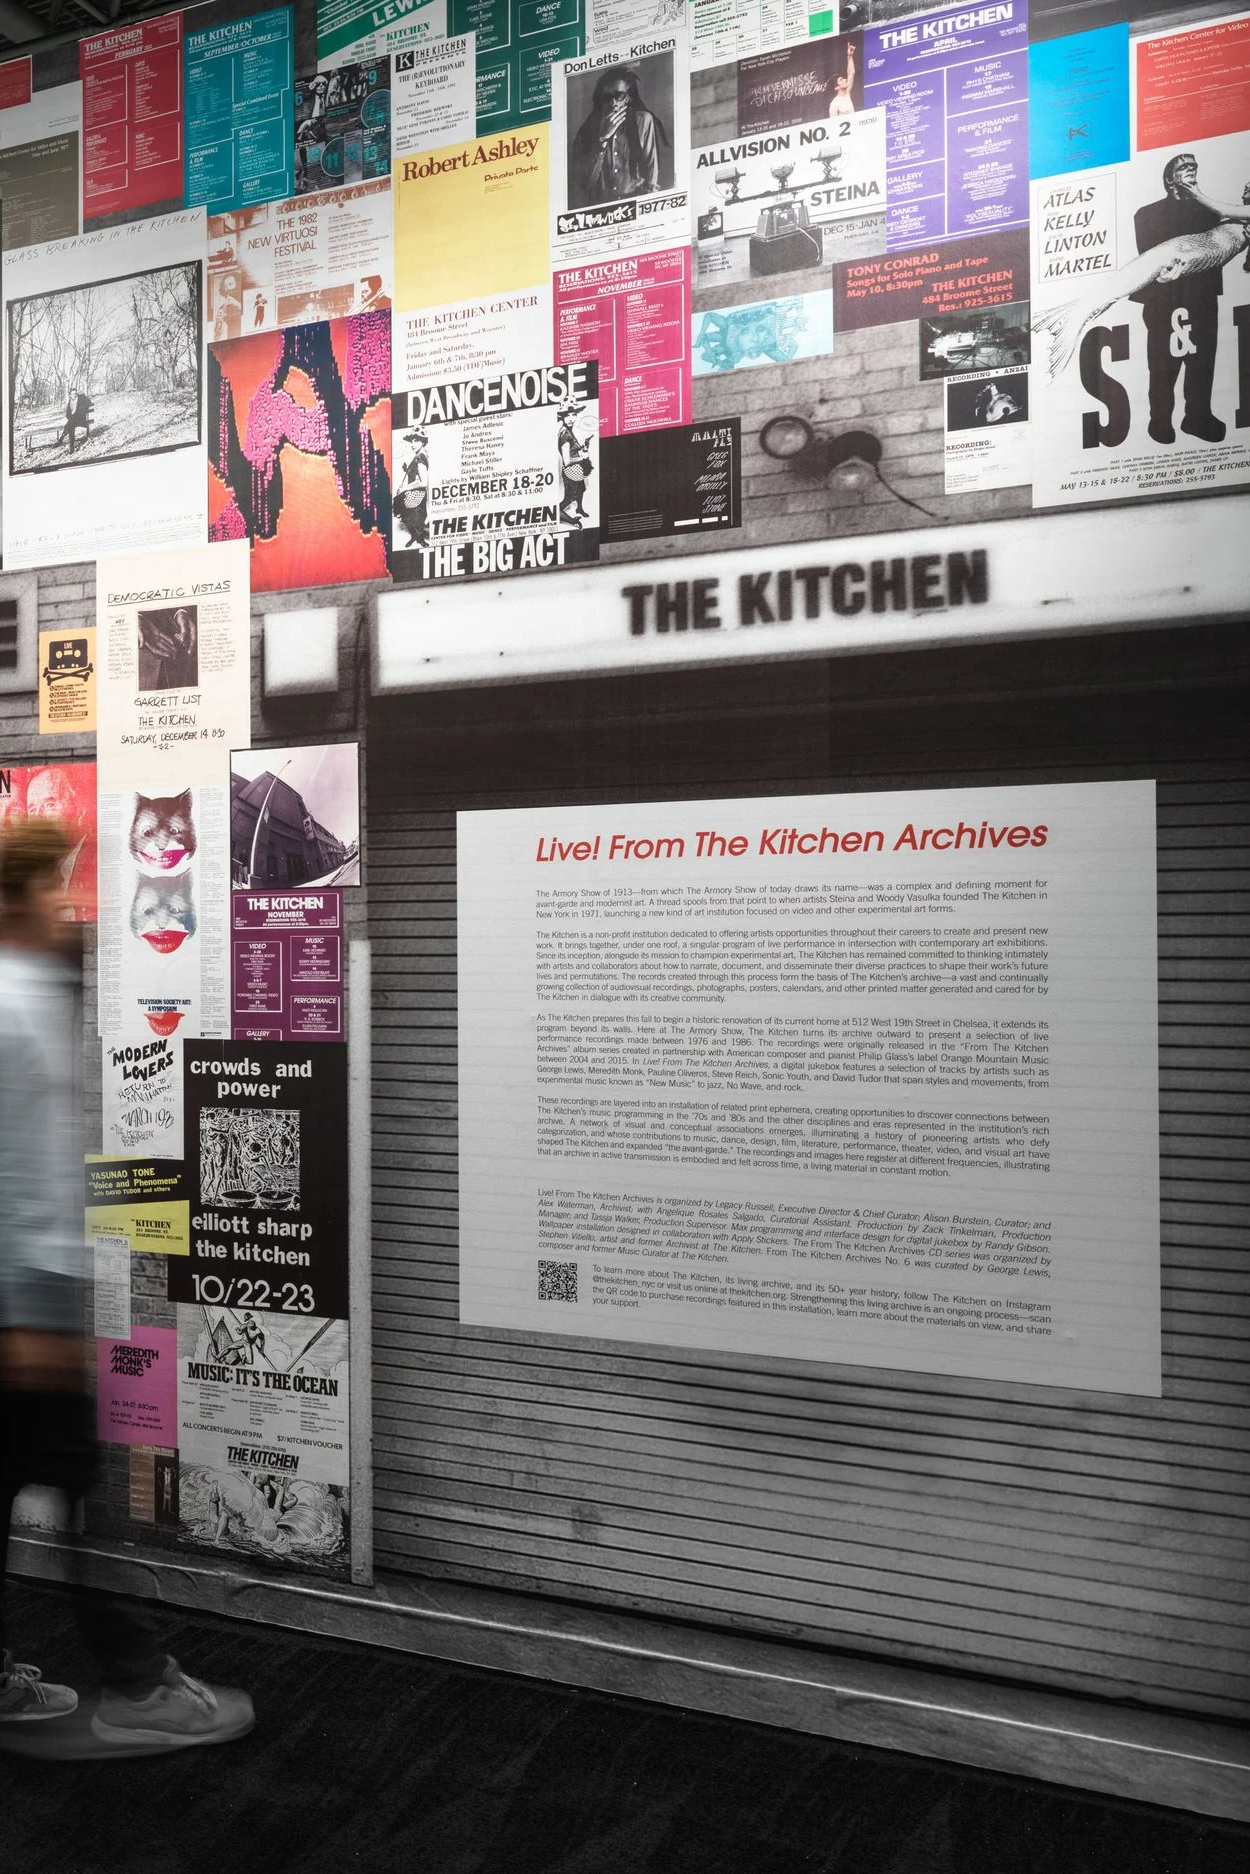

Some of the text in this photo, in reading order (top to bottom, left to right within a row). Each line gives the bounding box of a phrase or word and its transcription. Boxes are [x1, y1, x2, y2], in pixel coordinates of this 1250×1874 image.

[879, 3, 1013, 50] THE KITCHEN
[564, 37, 676, 75] Don Letts Kitchen
[697, 122, 851, 169] ALLVISION NO. 2
[402, 135, 539, 183] Robert Ashley
[810, 181, 880, 206] STEINA
[1043, 187, 1094, 209] ATLAS
[277, 213, 317, 230] THE 1982
[1043, 211, 1094, 231] KELLY
[4, 211, 203, 266] GLASS BREAKING IN THE KITCHEN
[247, 227, 318, 250] NEW VIRTUOSI
[273, 240, 317, 258] FESTIVAL
[1043, 232, 1107, 255] LINTON
[847, 253, 939, 278] TONY CONRAD
[1043, 254, 1112, 278] MARTEL
[922, 282, 1013, 304] 484 Broome Street
[408, 364, 588, 426] DANCENOISE
[432, 473, 553, 499] DECEMBER 18-20
[420, 532, 569, 579] THE BIG ACT
[107, 580, 231, 605] DEMOCRATIC VISTAS
[622, 550, 989, 635] THE KITCHEN
[536, 822, 1048, 863] Live! From The Kitchen Archives
[551, 993, 578, 1002] Kitchen
[591, 994, 621, 1003] dialogue
[650, 994, 679, 1003] creative
[681, 995, 727, 1004] community.
[190, 1058, 312, 1078] crowds and
[217, 1081, 280, 1099] power
[91, 1168, 155, 1179] YASUNAO TONE
[192, 1216, 312, 1240] elliott sharp
[188, 1362, 233, 1385] MUSIC:
[265, 1372, 291, 1391] THE
[294, 1374, 338, 1397] OCEAN
